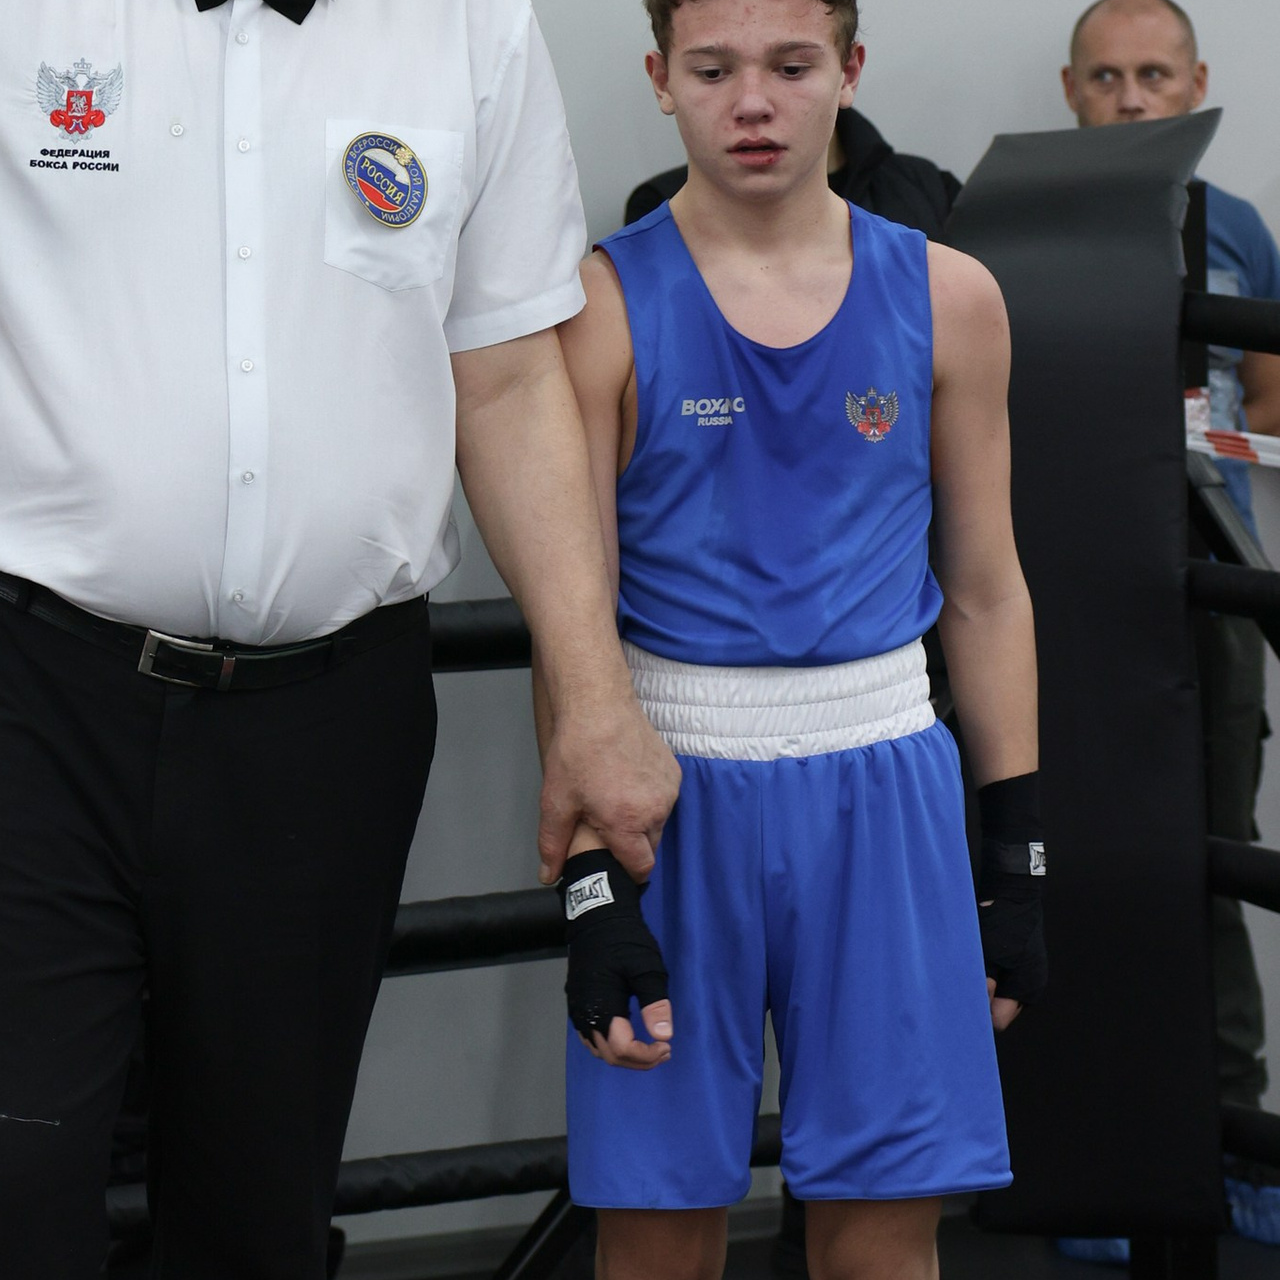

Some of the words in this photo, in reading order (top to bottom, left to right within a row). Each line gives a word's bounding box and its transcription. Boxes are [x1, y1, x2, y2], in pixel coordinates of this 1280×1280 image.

[40, 148, 110, 159] ФЕДЕРАЦИЯ
[30, 160, 68, 170] БОКСА
[72, 161, 120, 172] РОССИИ
[361, 158, 405, 204] РОССИЯ
[697, 416, 733, 426] RUSSIA
[569, 877, 607, 911] EVERLAST
